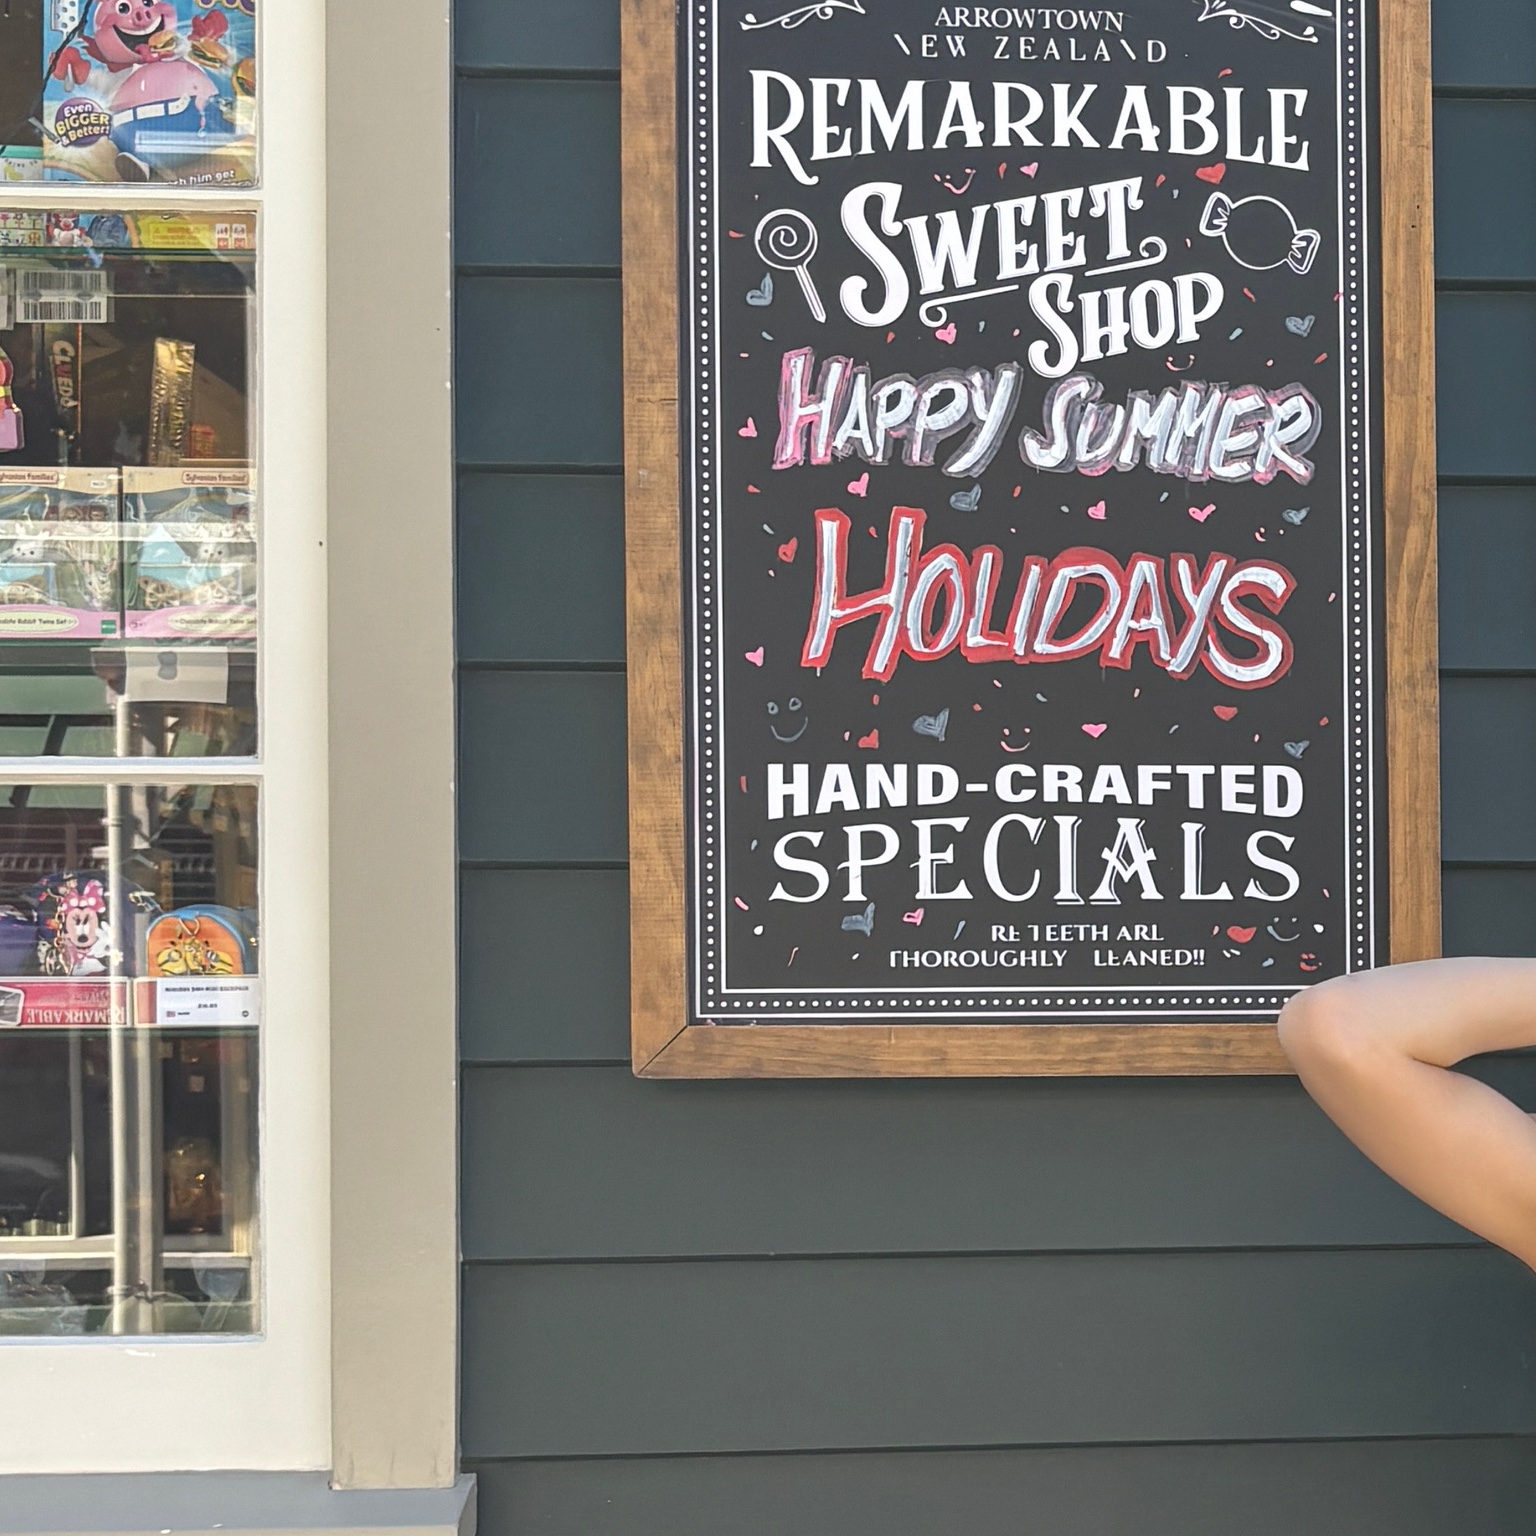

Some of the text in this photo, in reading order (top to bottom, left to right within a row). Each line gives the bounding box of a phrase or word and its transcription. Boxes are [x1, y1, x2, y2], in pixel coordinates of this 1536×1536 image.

[934, 7, 1125, 33] ARROWTOWN
[56, 113, 110, 136] BIGGER
[64, 104, 92, 117] Even
[749, 70, 1310, 185] REMARKABLE
[61, 125, 110, 146] & Better!
[215, 169, 234, 182] get
[839, 177, 1150, 328] SWEET
[1028, 272, 1225, 379] SHOP
[773, 346, 1318, 486] HAPPY SUMMER
[800, 507, 1298, 690] HOLIDAYS
[766, 762, 1305, 820] HAND-CRAFTED
[768, 812, 1302, 906] SPECIALS
[1028, 925, 1109, 942] TEETH
[889, 949, 1205, 967] THOROUGHLY LEANED!!
